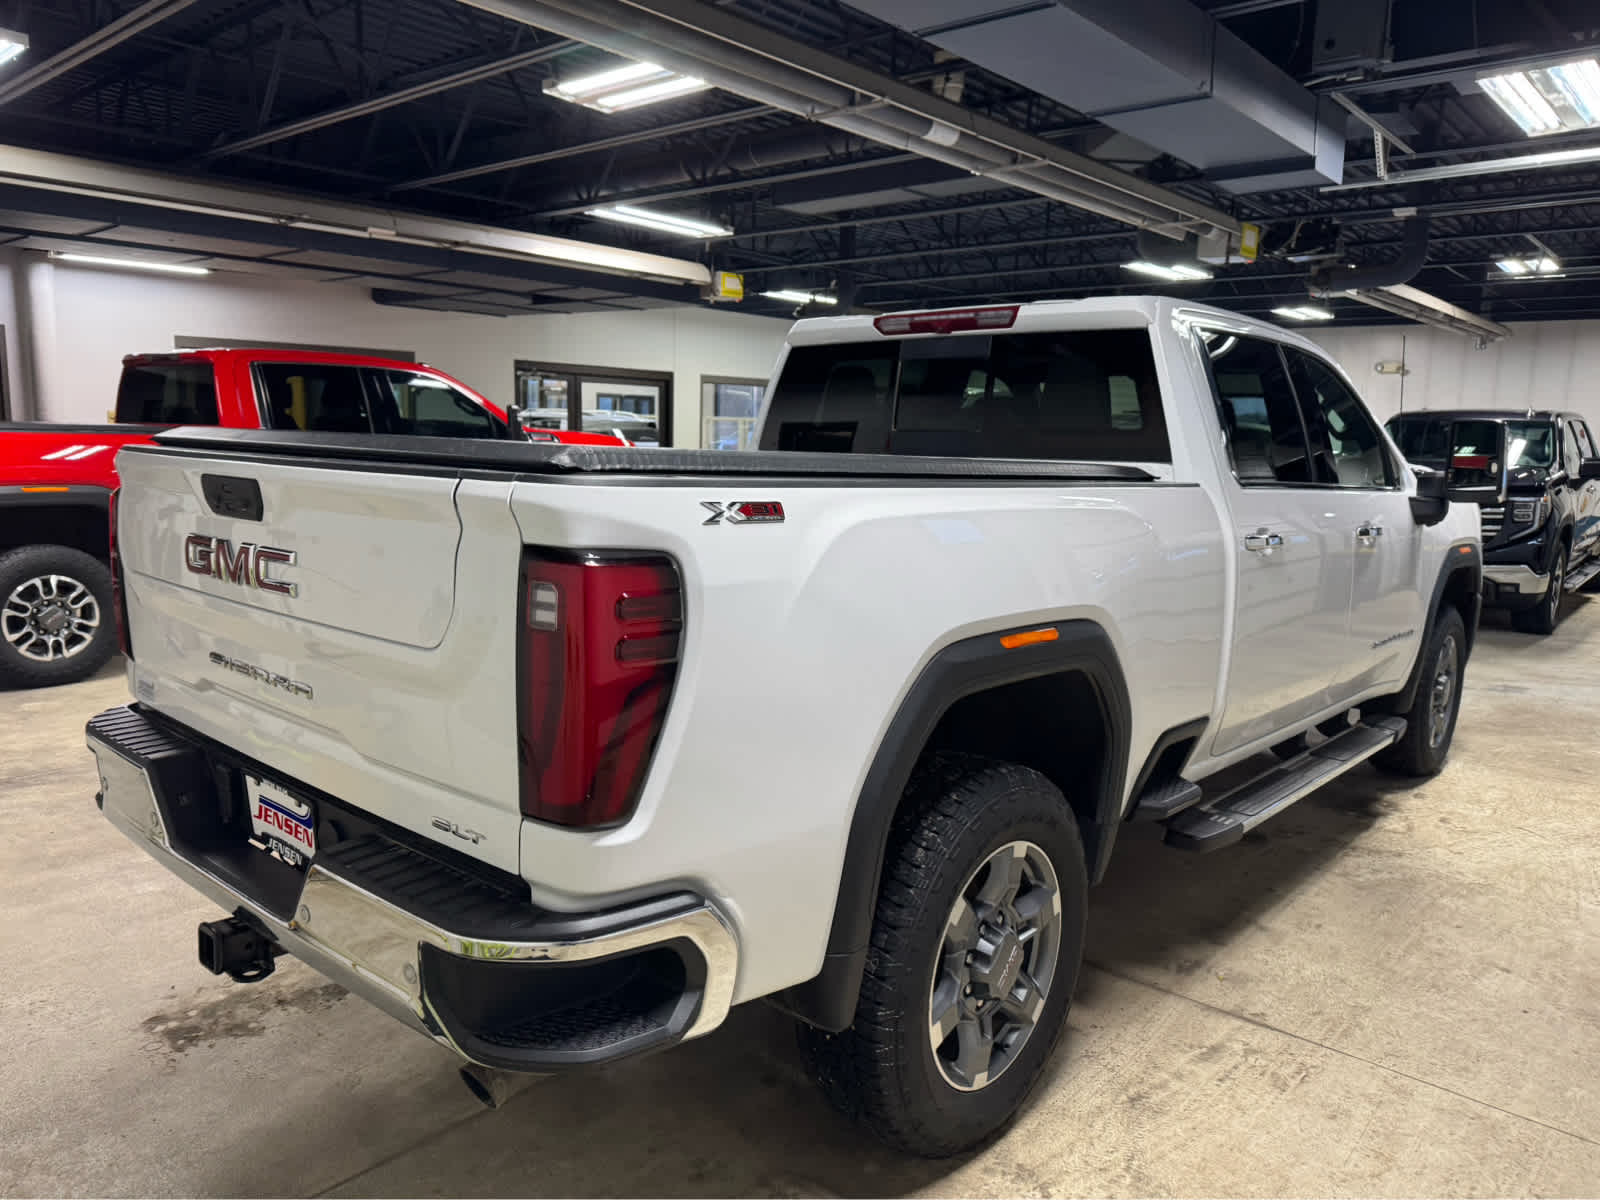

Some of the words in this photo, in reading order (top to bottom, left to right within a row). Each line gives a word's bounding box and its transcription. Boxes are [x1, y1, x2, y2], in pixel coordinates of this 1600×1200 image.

[185, 533, 298, 599] GMC
[209, 651, 314, 700] SIERRA
[253, 804, 313, 849] JENSEN
[431, 815, 488, 845] SLT
[267, 838, 303, 866] JENSEN
